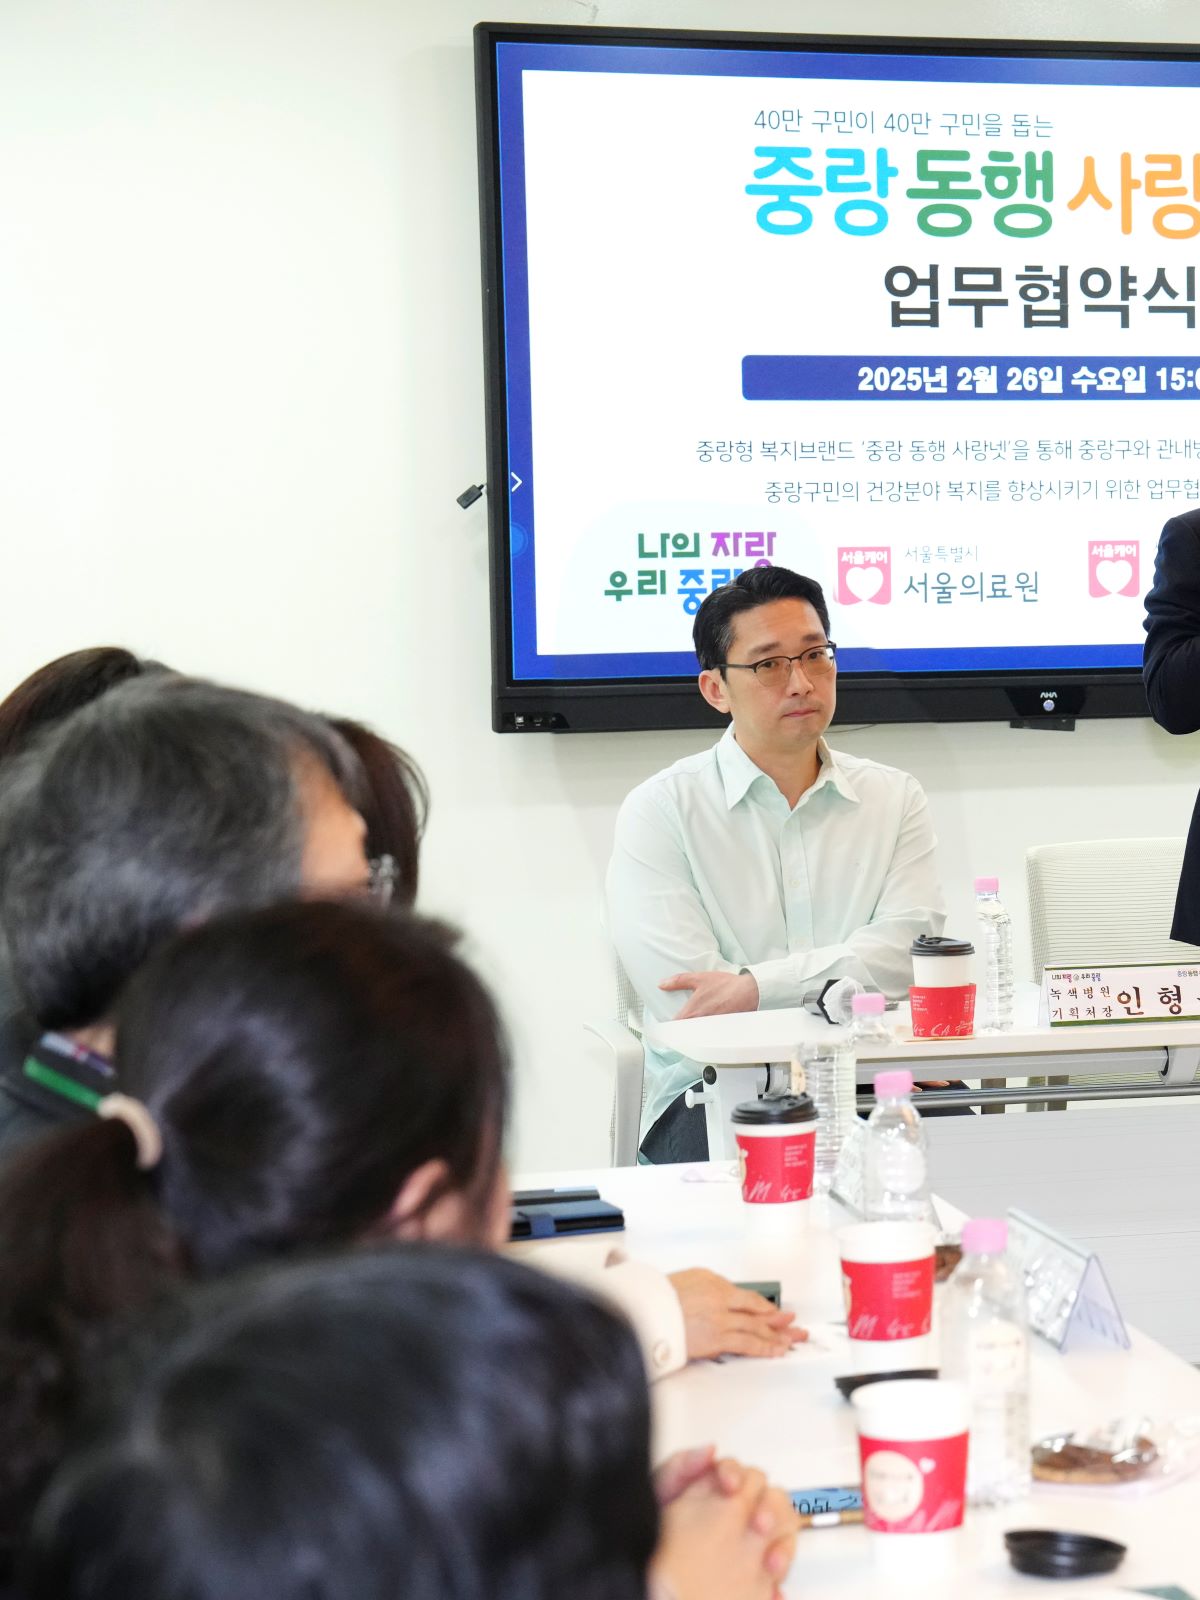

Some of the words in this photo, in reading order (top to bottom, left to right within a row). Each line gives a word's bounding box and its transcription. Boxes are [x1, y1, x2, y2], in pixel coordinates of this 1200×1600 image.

[754, 109, 803, 132] 40만
[811, 110, 874, 134] 구민이
[884, 112, 932, 135] 40만
[940, 113, 1003, 136] 구민을
[1011, 114, 1053, 138] 돕는
[745, 146, 899, 237] 중랑
[906, 149, 1054, 238] 동행
[884, 264, 1196, 329] 업무협약식
[858, 365, 948, 394] 2025년
[957, 365, 998, 393] 2월
[1006, 366, 1063, 394] 26일
[1071, 366, 1146, 394] 수요일
[696, 440, 752, 462] 중랑형
[760, 440, 855, 462] 복지브랜드
[909, 440, 945, 461] 동행
[1036, 440, 1071, 461] 통해
[1078, 440, 1151, 460] 중랑구와
[765, 481, 858, 503] 중랑구민의
[866, 480, 940, 503] 건강분야
[948, 480, 1001, 503] 복지를
[1008, 480, 1097, 501] 향상시키기
[1106, 480, 1141, 499] 위한
[638, 532, 701, 559] 나의
[710, 531, 777, 568] 자랑
[906, 546, 977, 563] 서울특별시
[604, 569, 667, 602] 우리
[904, 571, 1038, 604] 서울의료원
[1050, 986, 1111, 1000] 녹색병원
[1052, 1007, 1113, 1020] 기획처장
